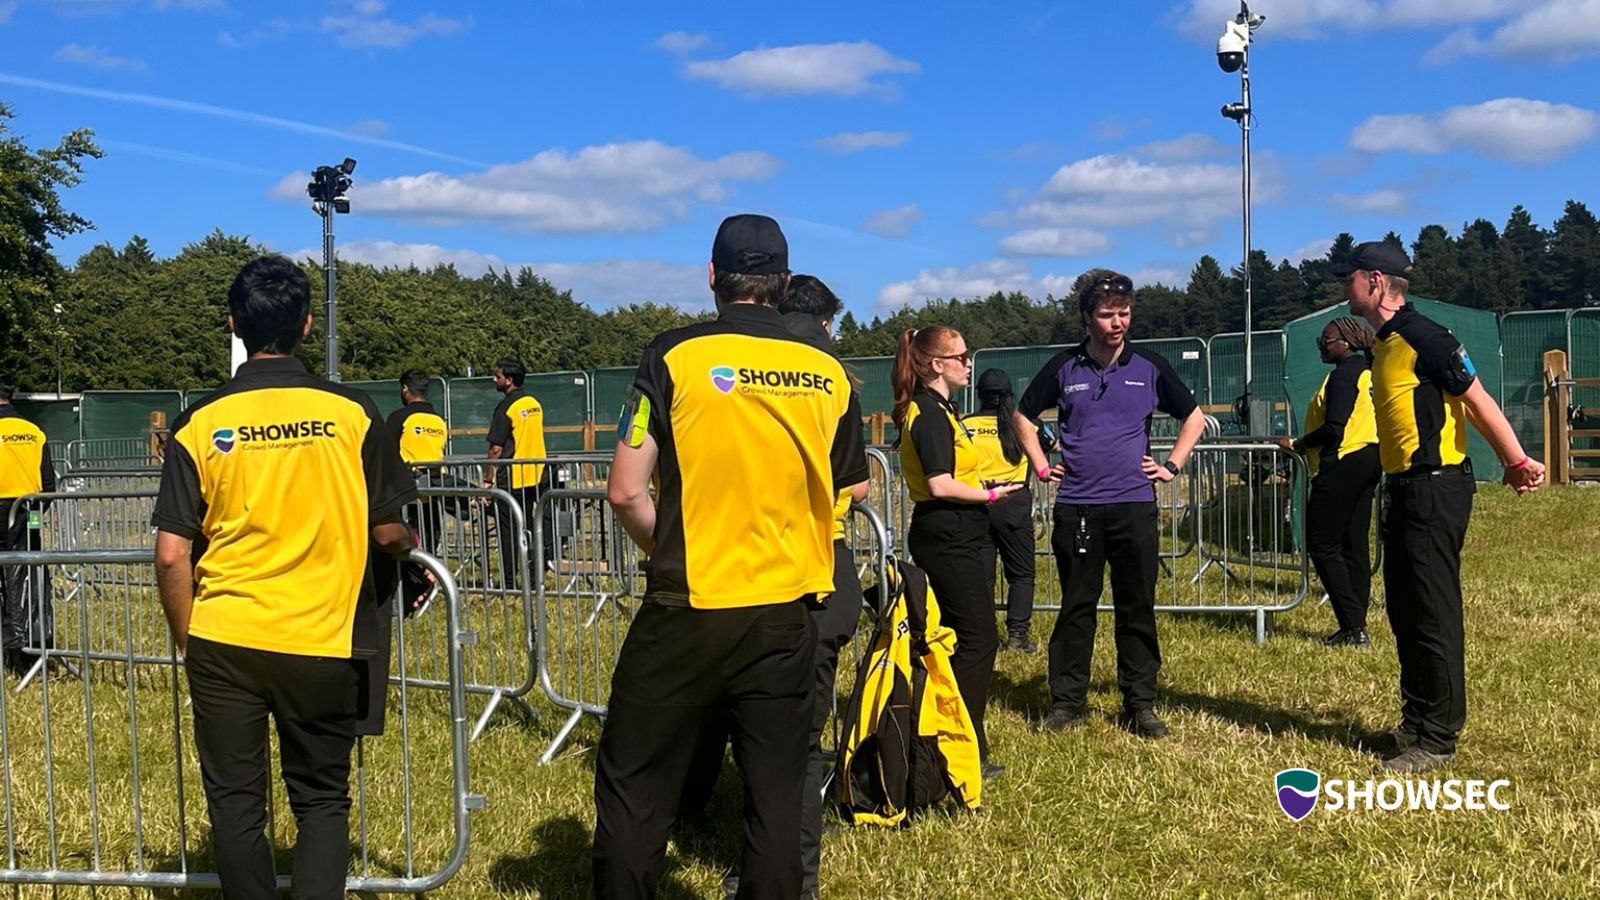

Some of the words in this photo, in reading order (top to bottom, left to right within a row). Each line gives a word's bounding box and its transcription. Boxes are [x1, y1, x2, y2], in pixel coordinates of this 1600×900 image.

[738, 368, 834, 395] SHOWSEC
[741, 385, 766, 395] Crowd
[767, 388, 815, 398] Management
[238, 420, 336, 442] SHOWSEC
[241, 443, 266, 451] Crowd
[268, 440, 314, 450] Management
